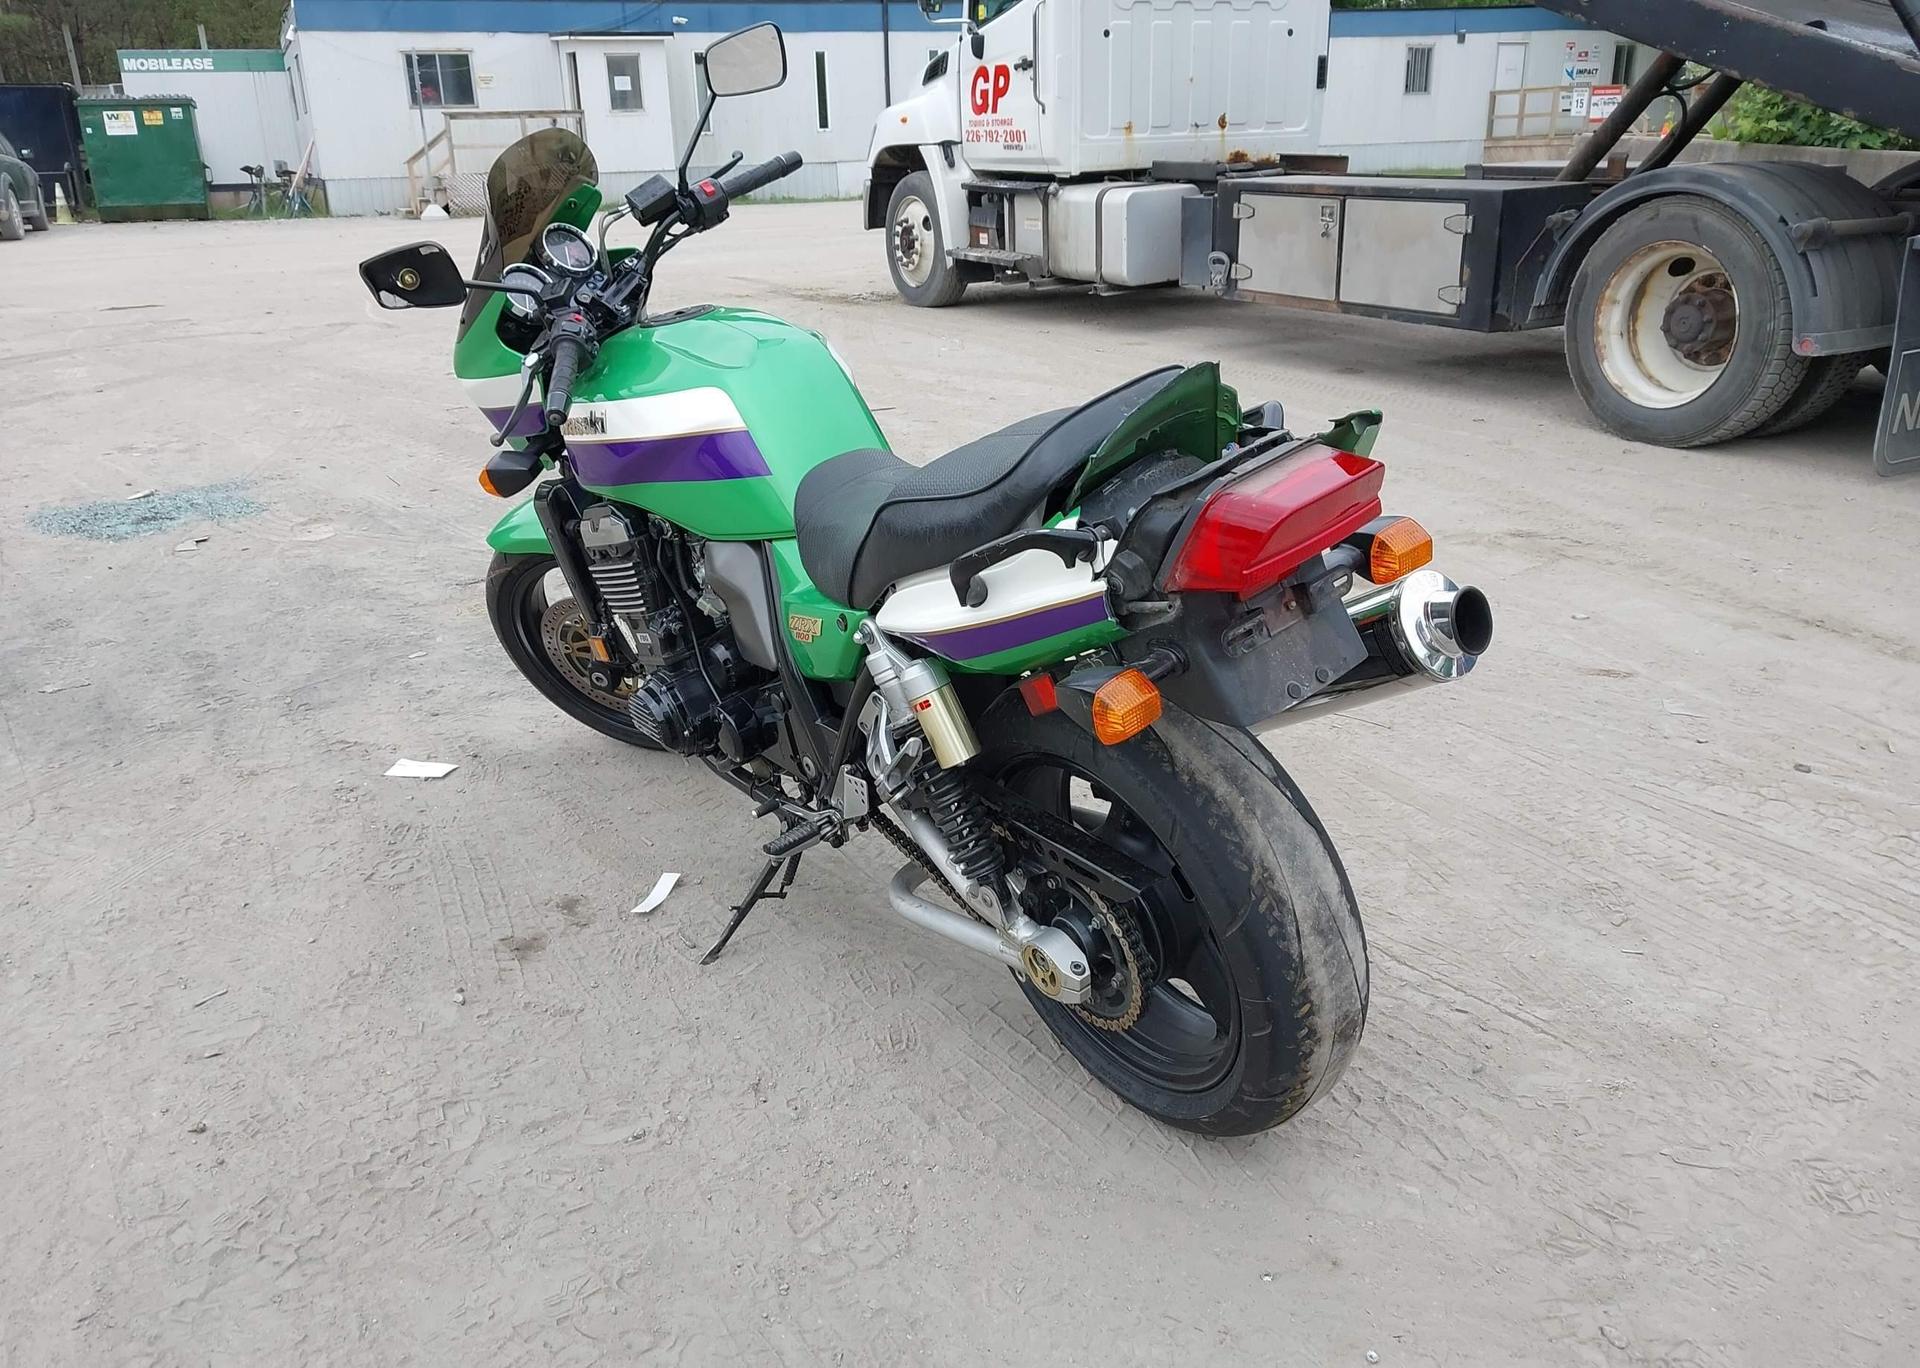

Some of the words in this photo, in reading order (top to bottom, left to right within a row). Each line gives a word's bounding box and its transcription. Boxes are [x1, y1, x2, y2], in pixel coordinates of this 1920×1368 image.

[122, 58, 214, 71] MOBILEASE
[971, 64, 1011, 116] GP
[1575, 98, 1584, 109] 15
[965, 129, 1027, 143] 226-792-2001
